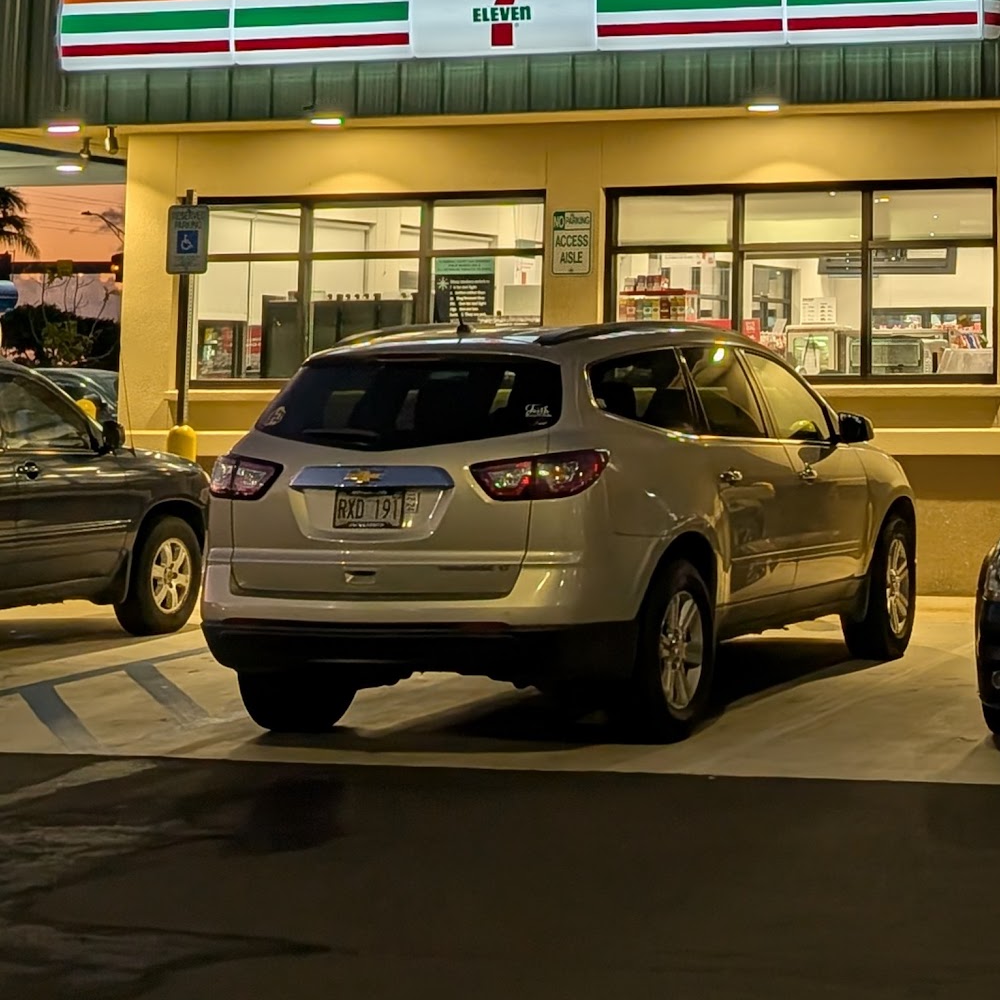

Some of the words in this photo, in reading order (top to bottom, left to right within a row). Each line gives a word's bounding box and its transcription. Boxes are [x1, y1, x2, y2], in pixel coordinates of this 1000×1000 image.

[554, 215, 565, 229] NO
[555, 234, 589, 248] ACCESS
[560, 251, 583, 264] AISLE
[337, 498, 365, 520] RXD
[374, 498, 398, 521] 191
